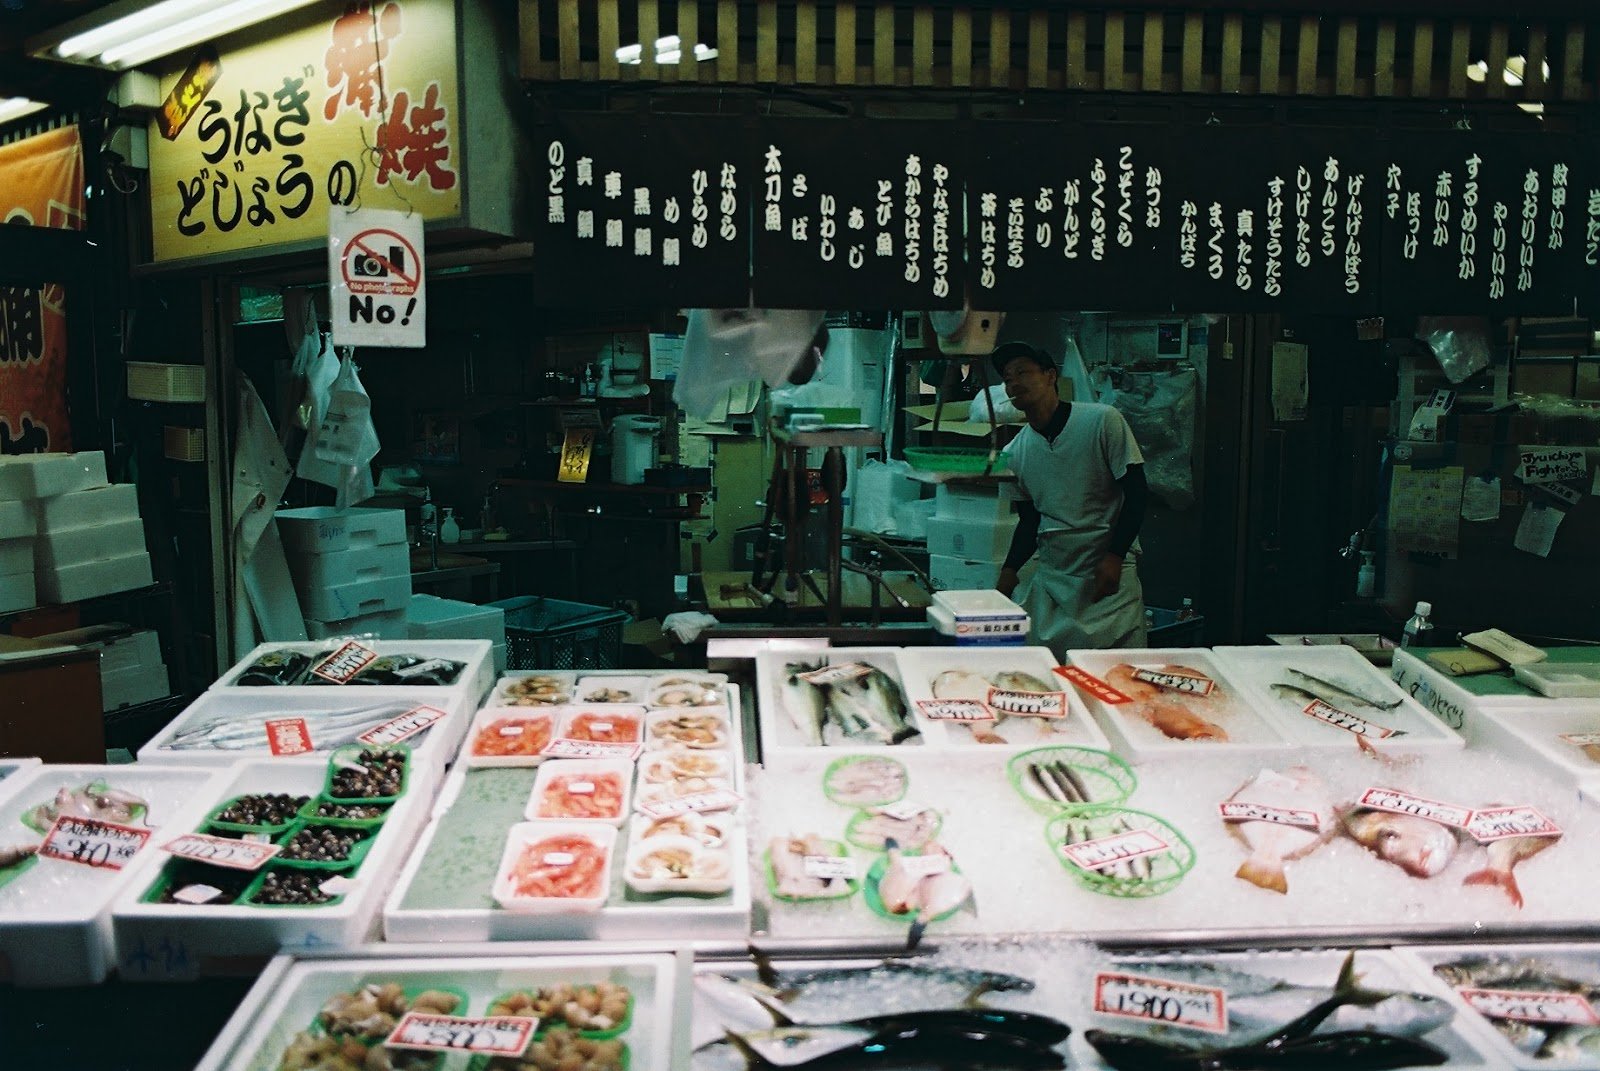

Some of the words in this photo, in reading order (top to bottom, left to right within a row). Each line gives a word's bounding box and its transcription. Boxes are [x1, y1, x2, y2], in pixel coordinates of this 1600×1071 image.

[197, 63, 316, 164] うなぎ
[691, 169, 709, 249] ひらめ
[719, 161, 737, 241] なめら
[764, 144, 782, 231] 太刀魚
[791, 173, 809, 241] さば
[819, 193, 836, 262] いわし
[875, 179, 894, 257] とび魚
[904, 153, 922, 283] あからはちめ
[1034, 186, 1054, 249] ぶり
[1063, 178, 1081, 259] がんど
[1090, 157, 1107, 261] ふくらぎ
[1116, 145, 1135, 248] こぞくら
[1145, 165, 1162, 228] かつお
[1295, 165, 1312, 268] しげたら
[1320, 156, 1340, 257] あんこう
[1386, 162, 1402, 219] 穴子
[1403, 191, 1421, 260] ほっけ
[1432, 170, 1452, 247] 赤いか
[1458, 152, 1482, 280] するめいか
[847, 206, 865, 269] あじ
[932, 163, 950, 298] やなぎはちめ
[1207, 201, 1226, 280] まぐろ
[1235, 208, 1254, 291] 真たら
[1264, 175, 1285, 297] すけそうたら
[1489, 201, 1508, 300] やりいか
[1517, 168, 1540, 292] あおりいか
